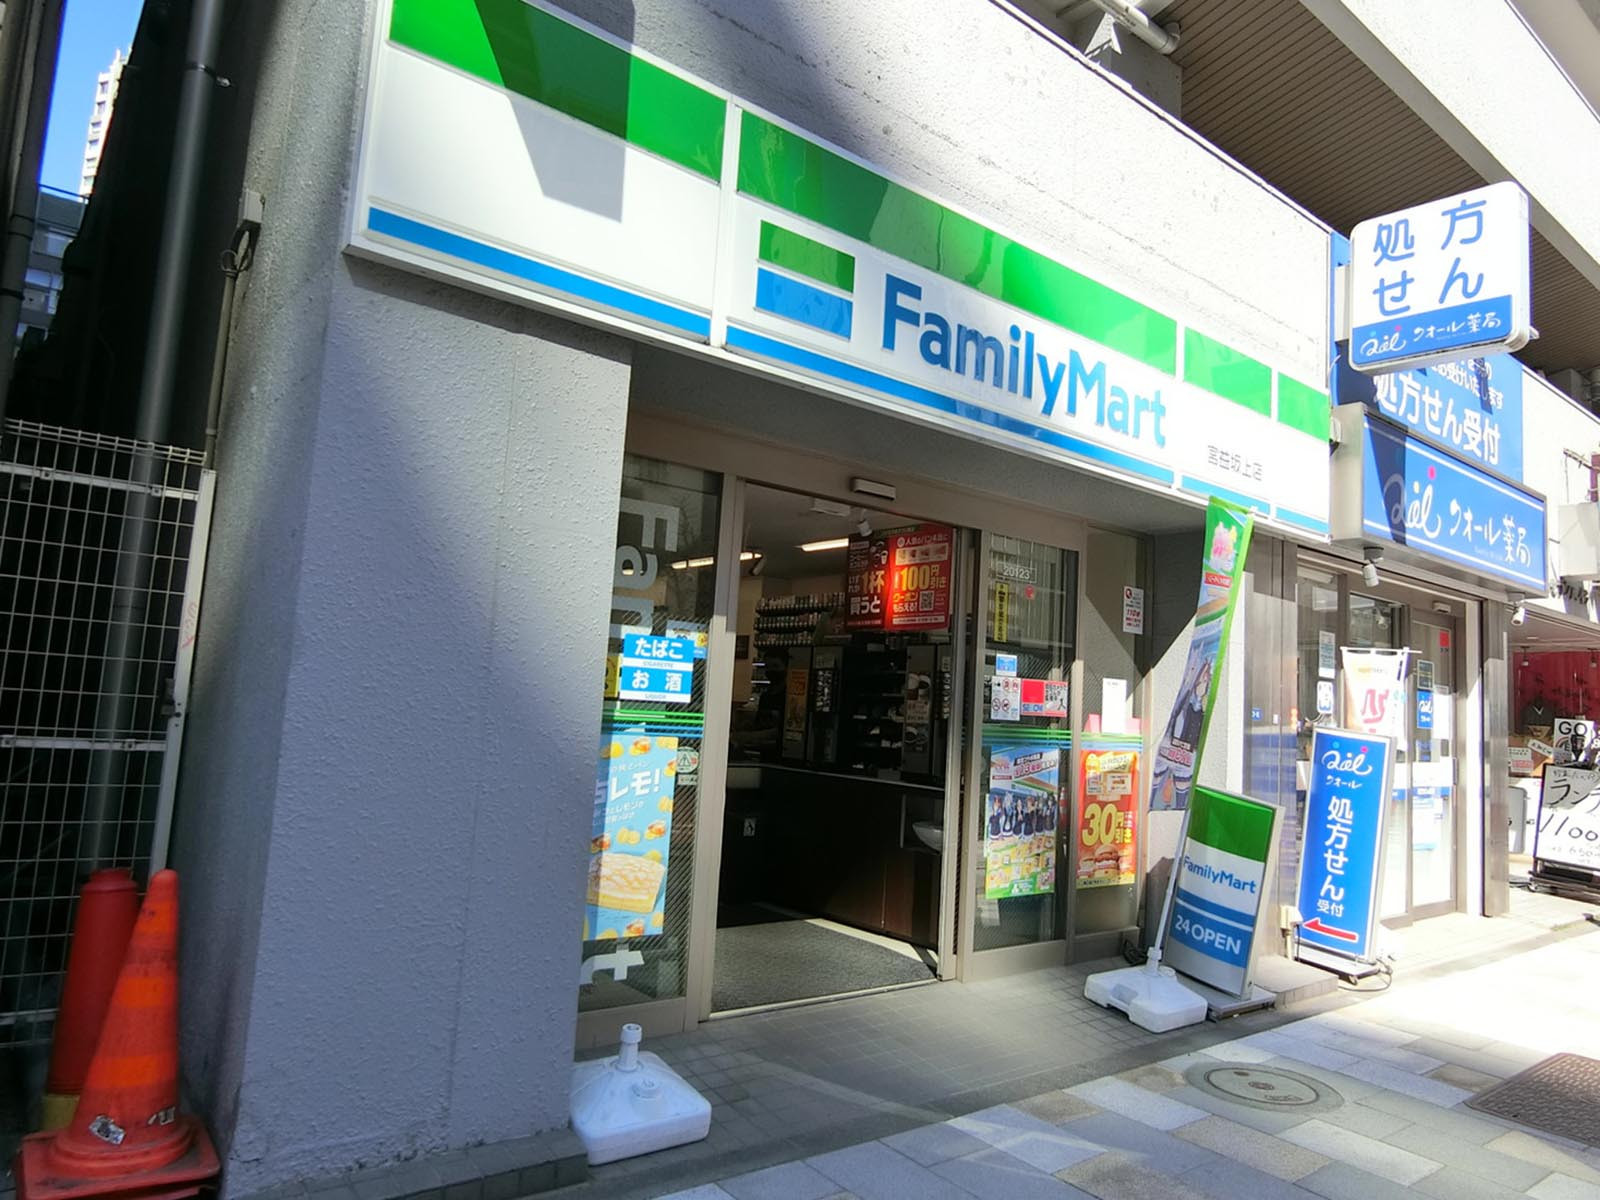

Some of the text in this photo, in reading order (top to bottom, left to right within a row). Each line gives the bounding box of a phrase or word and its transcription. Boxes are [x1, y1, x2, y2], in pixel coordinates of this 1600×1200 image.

[1372, 199, 1488, 267] 処方
[1371, 257, 1484, 317] せん
[881, 273, 1168, 448] FamilyMart
[1449, 498, 1532, 568] クオール薬局
[901, 565, 930, 591] 100
[1003, 567, 1031, 580] 20123
[850, 596, 881, 615] 買うと
[634, 637, 684, 660] たばこ
[1558, 721, 1588, 735] GO
[1325, 774, 1364, 790] クオール
[1082, 803, 1118, 846] 30
[1318, 796, 1354, 901] 処方せん
[1183, 855, 1257, 894] FamilyMart
[1316, 900, 1345, 918] 受付
